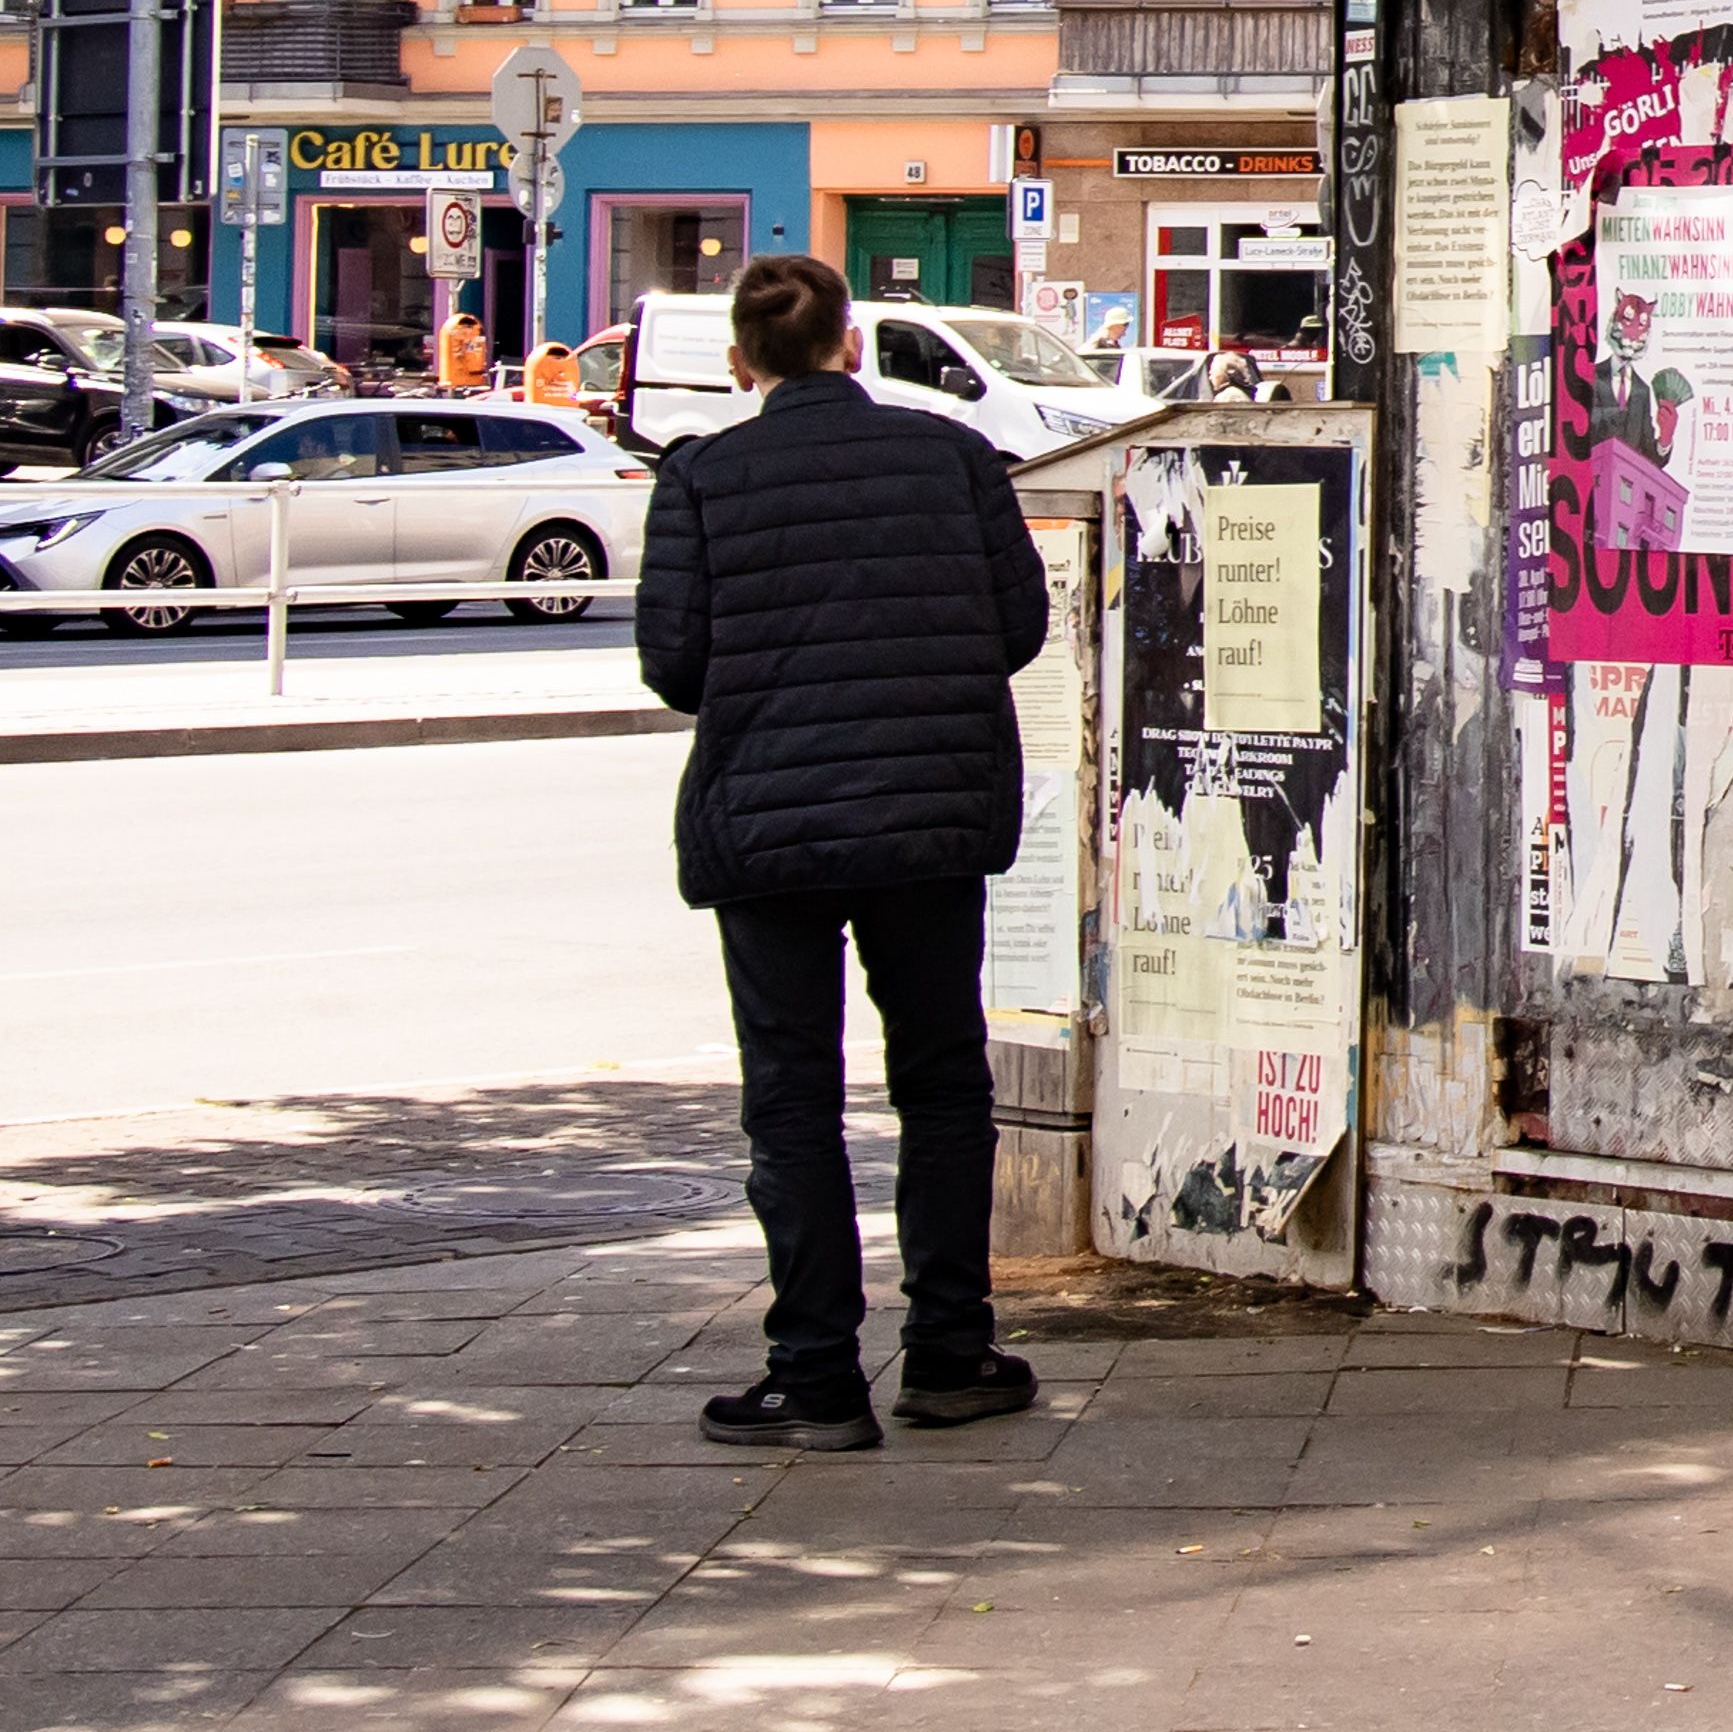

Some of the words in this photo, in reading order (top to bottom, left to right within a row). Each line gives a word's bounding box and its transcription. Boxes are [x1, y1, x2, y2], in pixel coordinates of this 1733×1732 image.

[290, 130, 400, 170] Café
[1126, 155, 1221, 173] TOBACCO
[1239, 155, 1314, 173] DRINKS
[1026, 191, 1042, 219] P
[1601, 217, 1725, 242] MIETENWAHNSINN
[1217, 515, 1276, 541] Preise
[1217, 557, 1281, 583] runter!
[1217, 597, 1279, 624] Löhne
[1217, 639, 1263, 666] rauf!
[1133, 947, 1176, 976] rauf!
[1256, 1092, 1319, 1144] HOCH!
